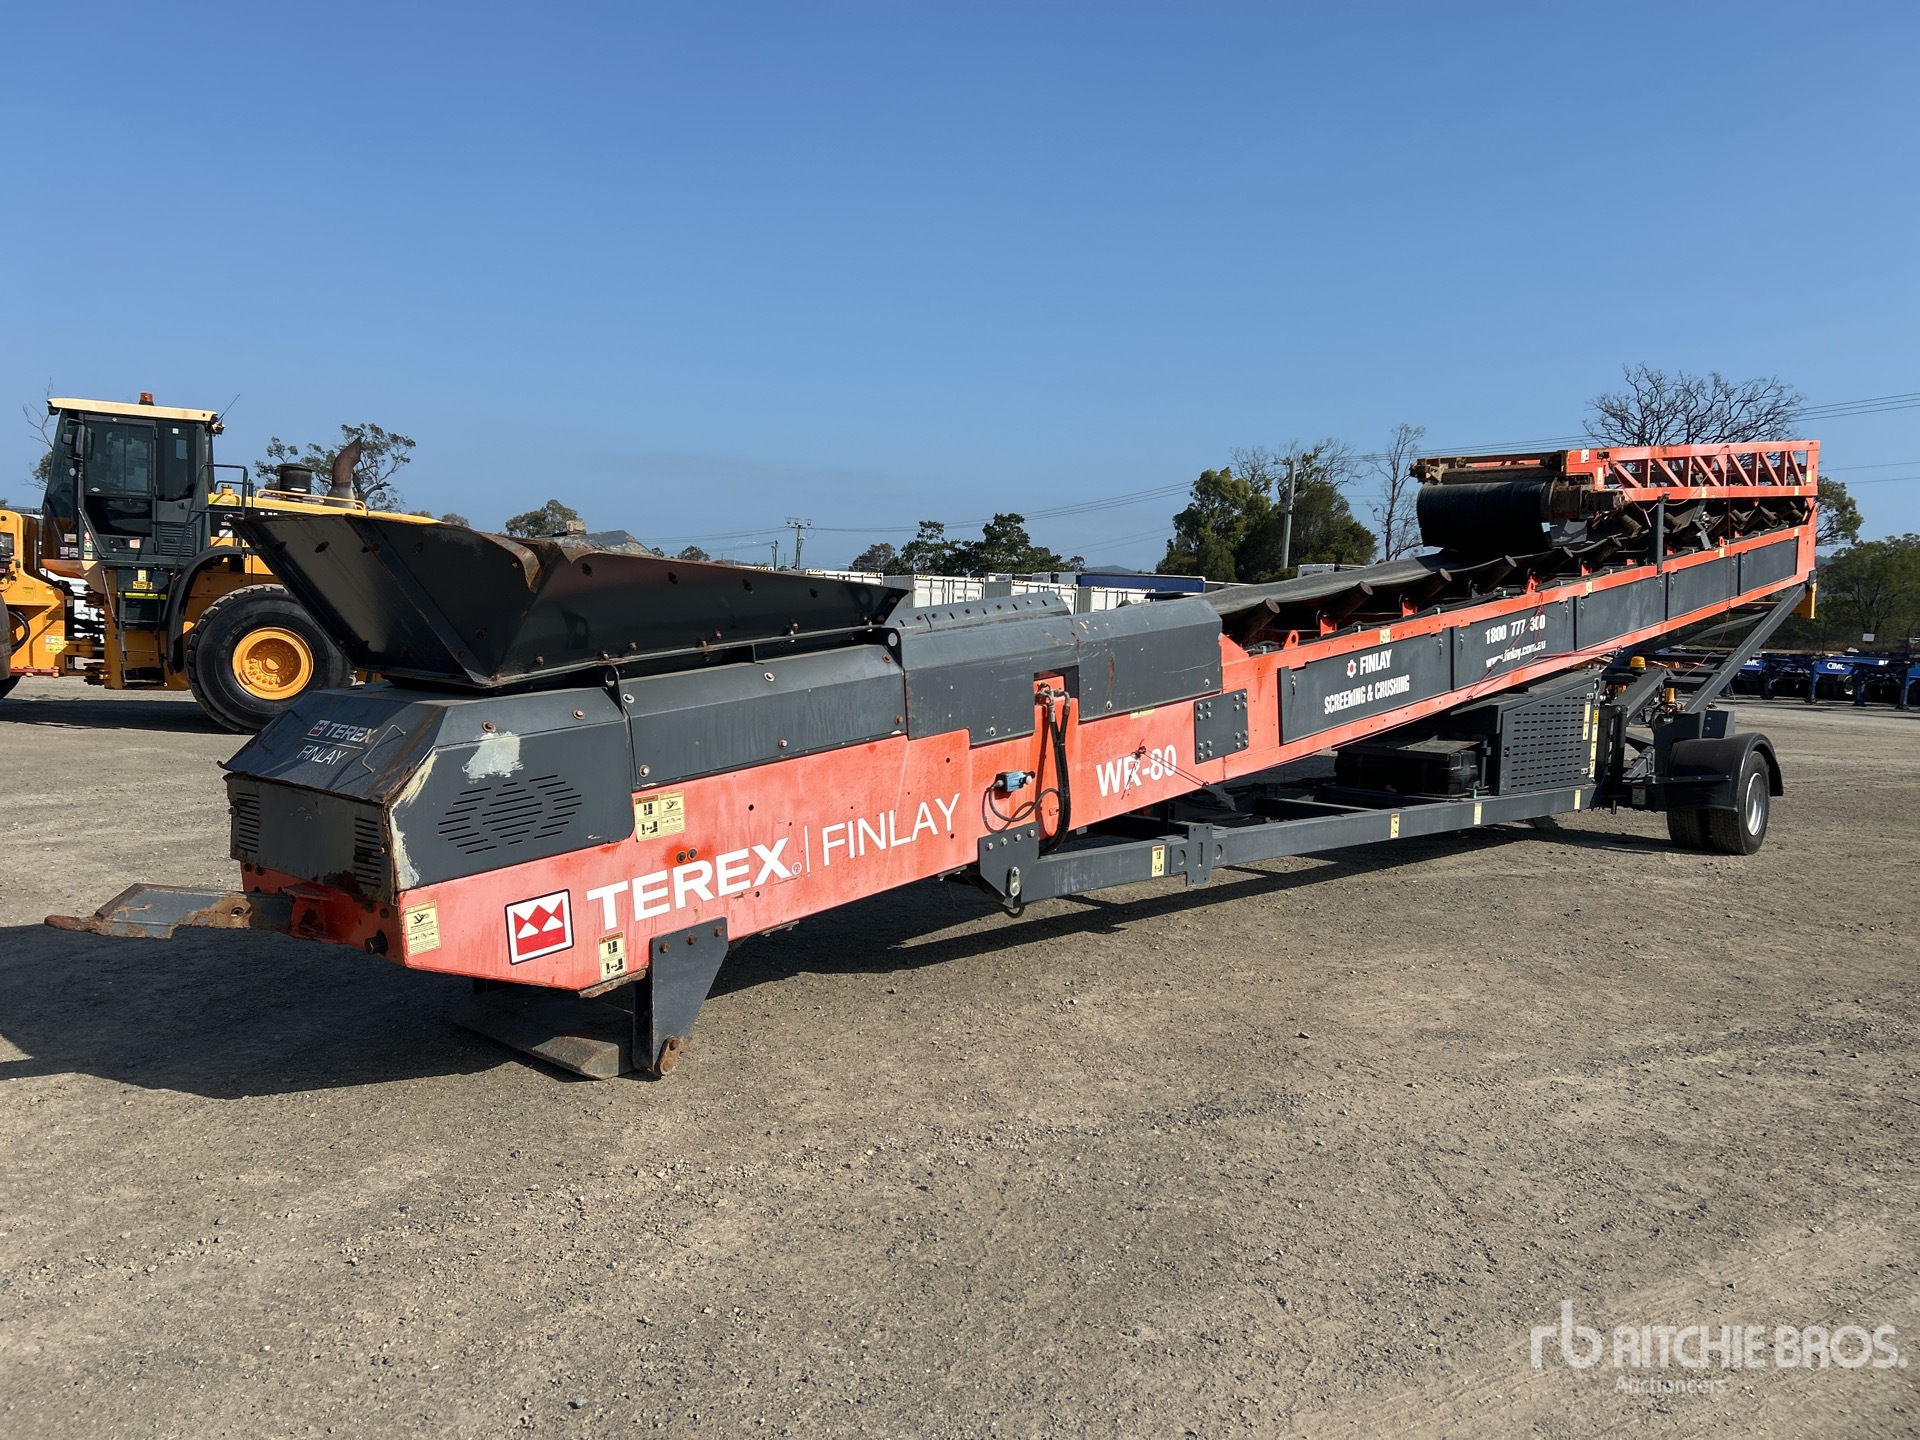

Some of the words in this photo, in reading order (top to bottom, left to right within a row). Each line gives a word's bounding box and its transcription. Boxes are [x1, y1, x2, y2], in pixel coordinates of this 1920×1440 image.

[1485, 625, 1507, 645] 1800
[1511, 619, 1526, 637] 777
[1359, 648, 1393, 676] FINLAY
[1826, 662, 1846, 671] CIMC
[1324, 685, 1366, 715] SCREENING
[1367, 683, 1374, 702] &
[1374, 674, 1410, 700] CRUSHING
[325, 722, 378, 743] TEREX
[296, 744, 348, 766] FINLAY
[1095, 744, 1177, 798] WR-80
[586, 836, 793, 931] TEREX
[821, 792, 961, 868] FINLAY
